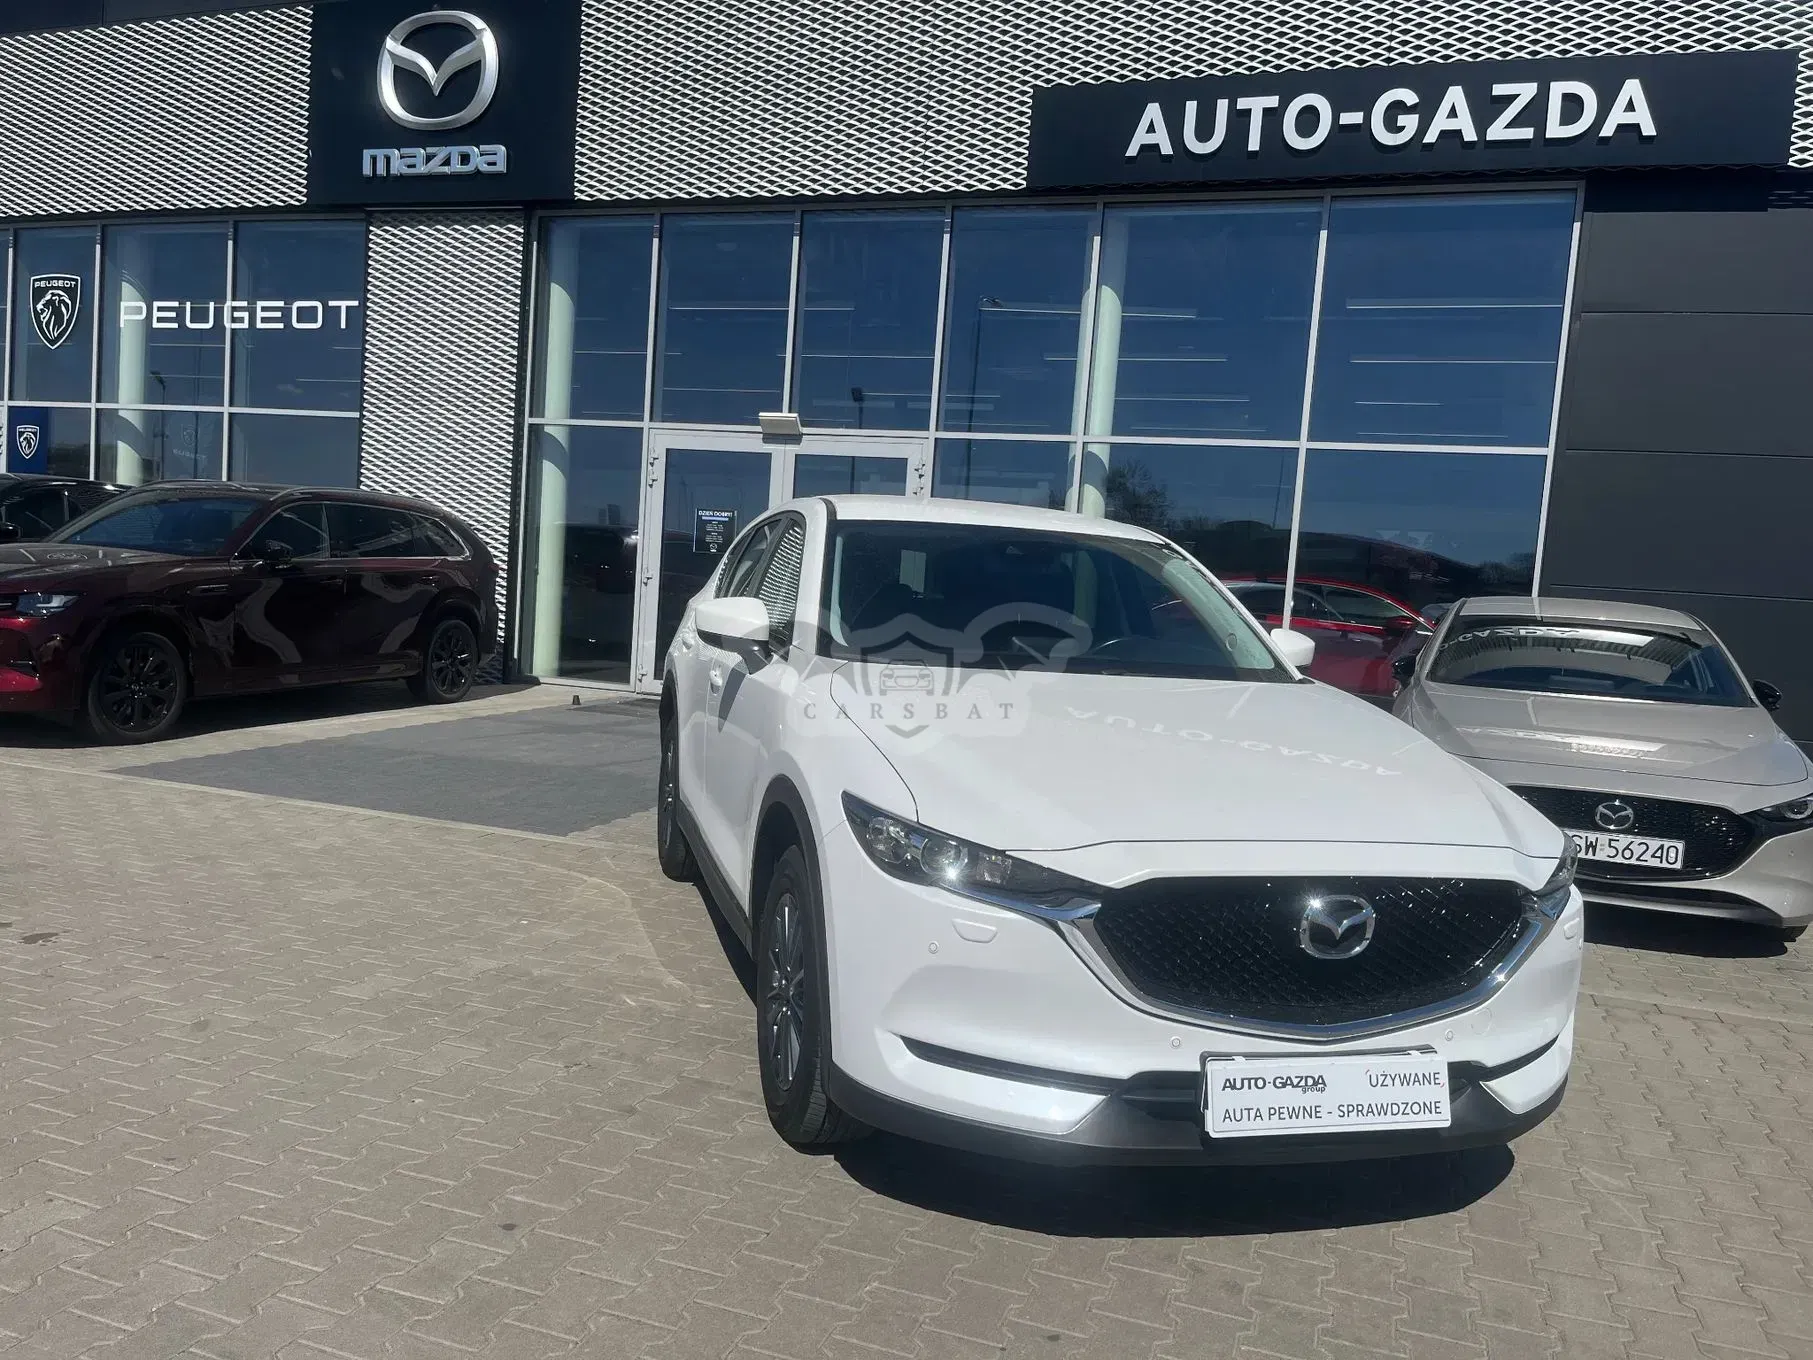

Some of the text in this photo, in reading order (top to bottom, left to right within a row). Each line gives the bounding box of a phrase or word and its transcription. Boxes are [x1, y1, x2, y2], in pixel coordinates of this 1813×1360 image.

[1124, 78, 1658, 157] AUTO-GAZDA
[34, 280, 77, 288] PEUGEOT
[119, 300, 360, 329] PEUGEOT
[1606, 838, 1680, 866] 56240
[1221, 1075, 1327, 1092] AUTO-GAZDA
[1368, 1070, 1442, 1088] UŻYWANE
[1301, 1085, 1327, 1095] group
[1222, 1107, 1264, 1123] AUTA
[1268, 1105, 1323, 1121] PEWNE
[1337, 1101, 1442, 1119] SPRAWDZONE
